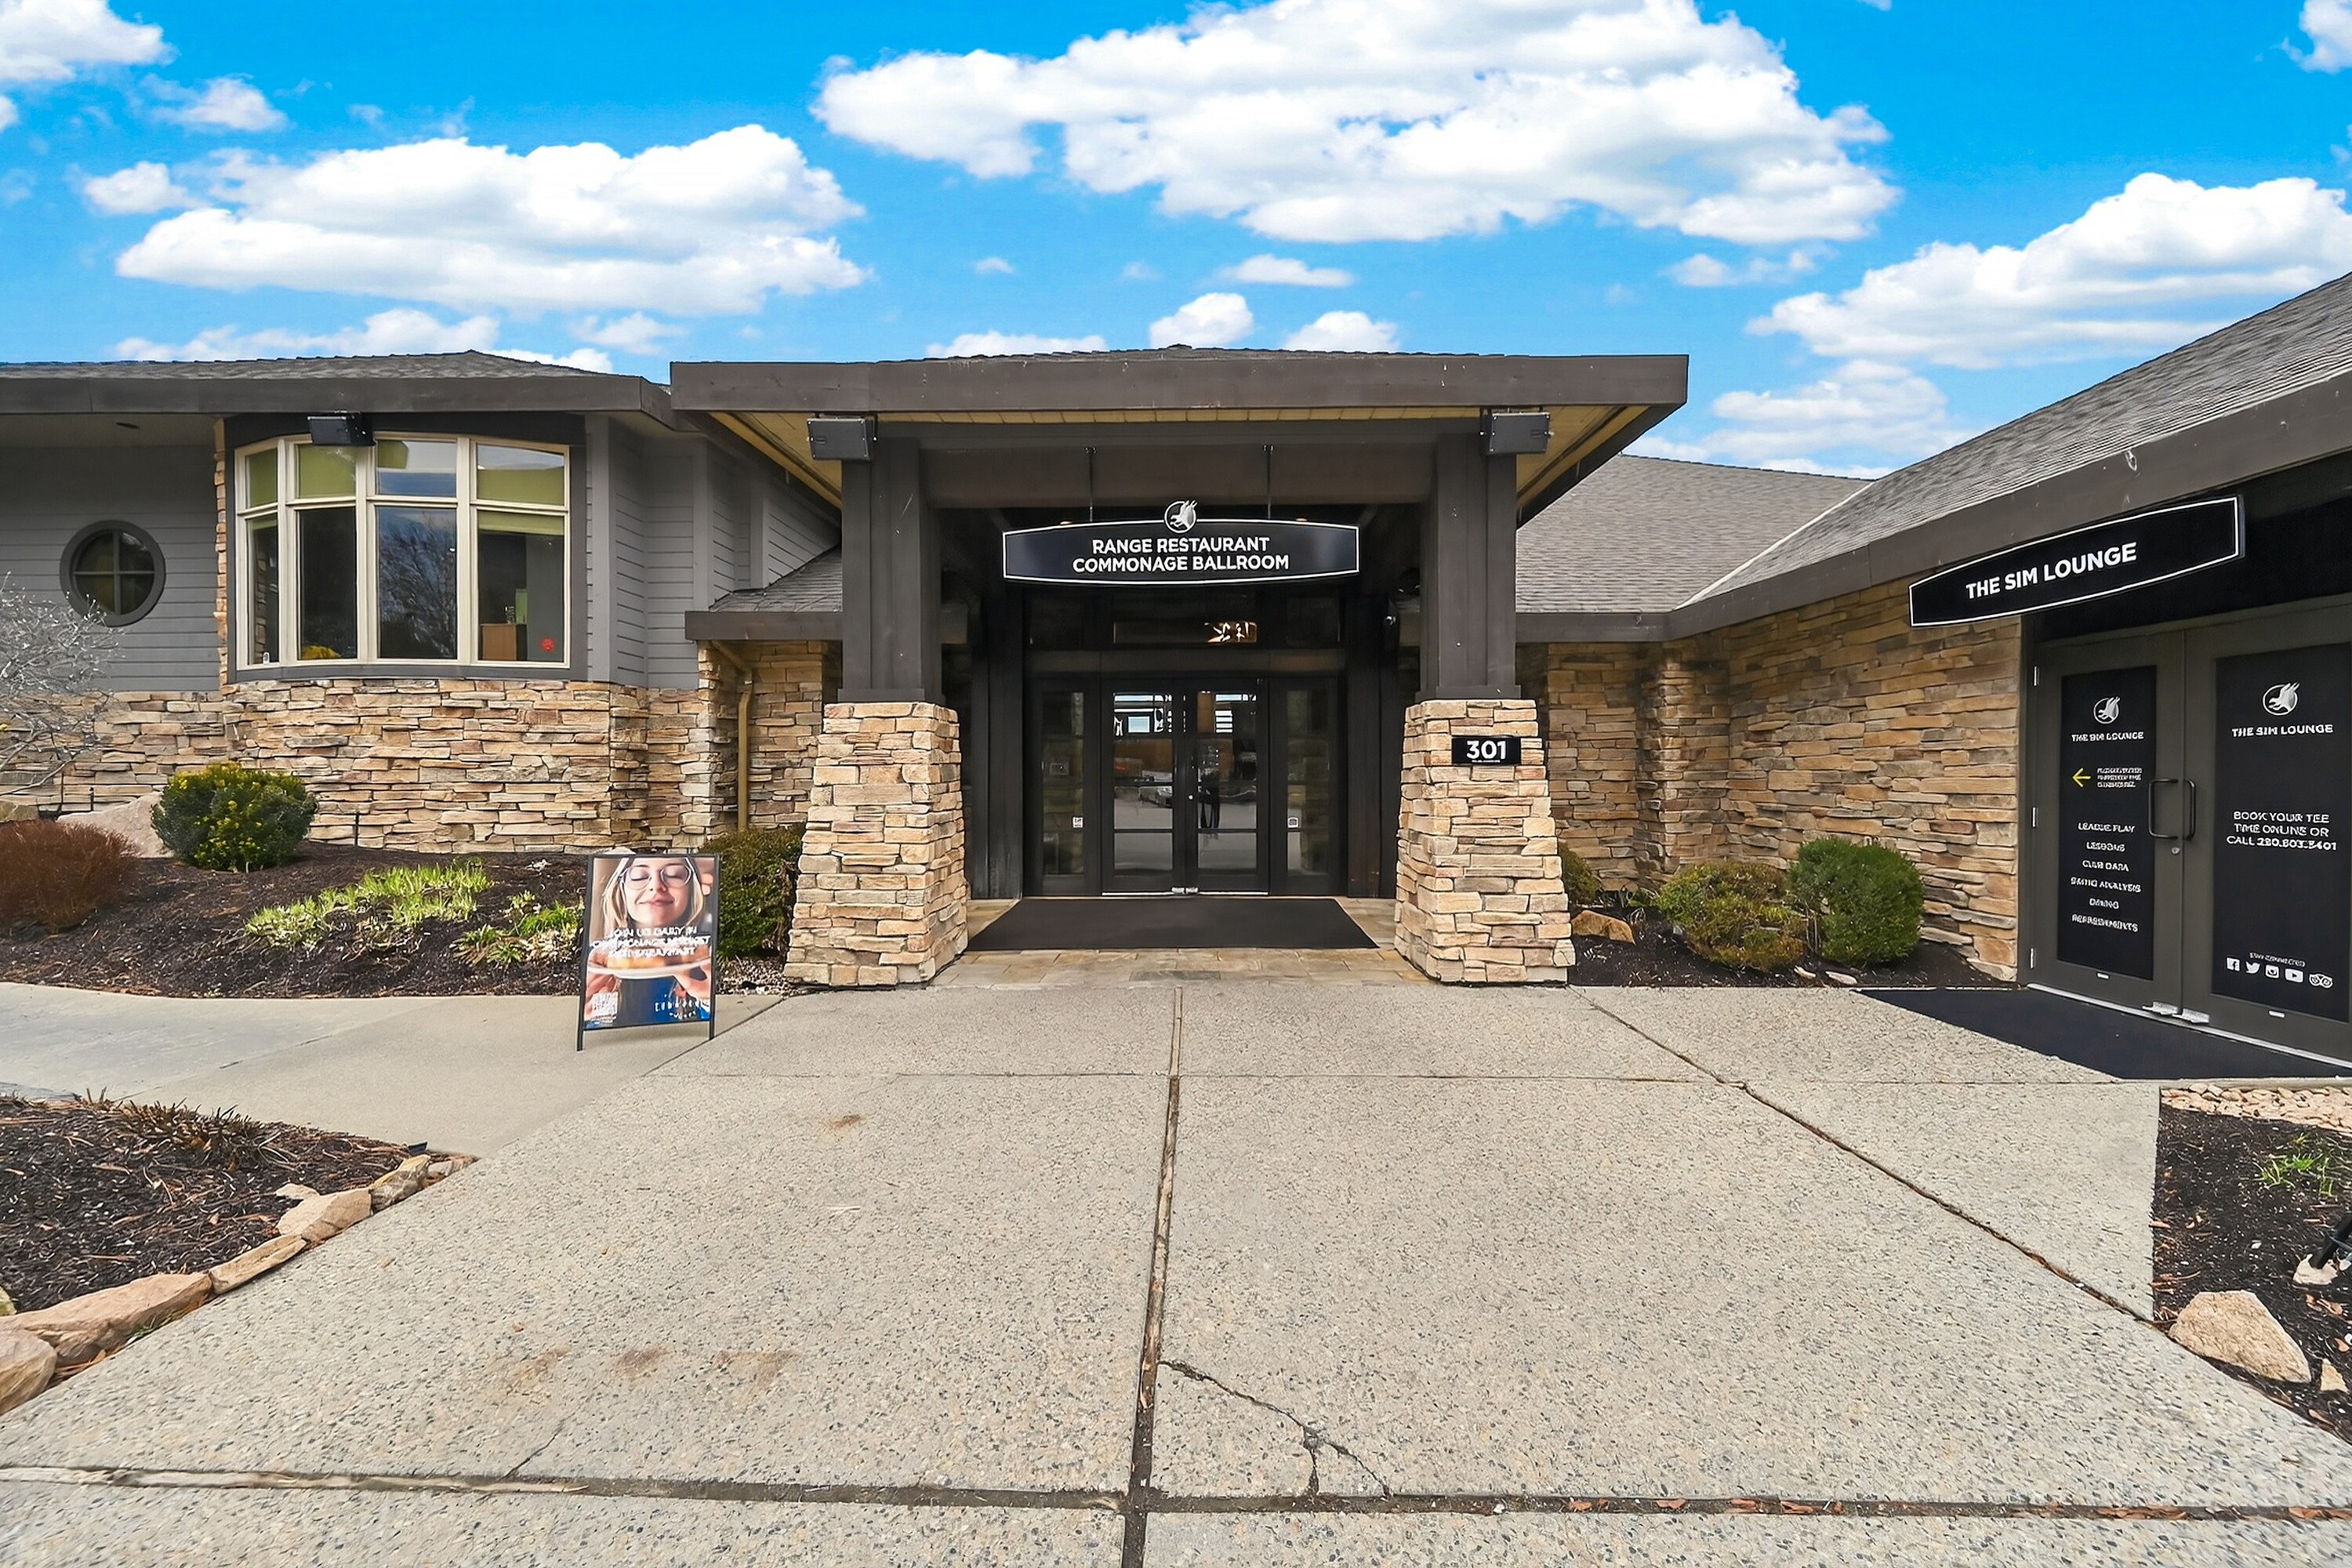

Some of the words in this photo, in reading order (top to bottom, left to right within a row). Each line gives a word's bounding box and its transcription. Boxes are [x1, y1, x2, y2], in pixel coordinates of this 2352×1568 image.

[1092, 538, 1152, 554] RANGE
[1156, 537, 1270, 553] RESTAURANT
[1073, 556, 1188, 572] COMMONAGE
[1192, 554, 1289, 571] BALLROOM
[1965, 576, 2001, 599] THE
[2004, 567, 2038, 590] SIM
[2043, 542, 2137, 582] LOUNGE
[2071, 733, 2089, 742] THE
[2106, 731, 2144, 741] LOUNGE
[2231, 728, 2255, 737] THE
[2256, 726, 2278, 736] SIM
[2280, 724, 2334, 735] LOUNGE
[1466, 740, 1506, 760] 301
[2233, 811, 2267, 822] BOOK
[2269, 812, 2303, 822] YOUR
[2306, 814, 2330, 823] TEE
[2233, 822, 2261, 833] TIME
[2262, 824, 2307, 837] ONLINE
[2309, 827, 2330, 837] OR
[2226, 835, 2255, 846] CALL
